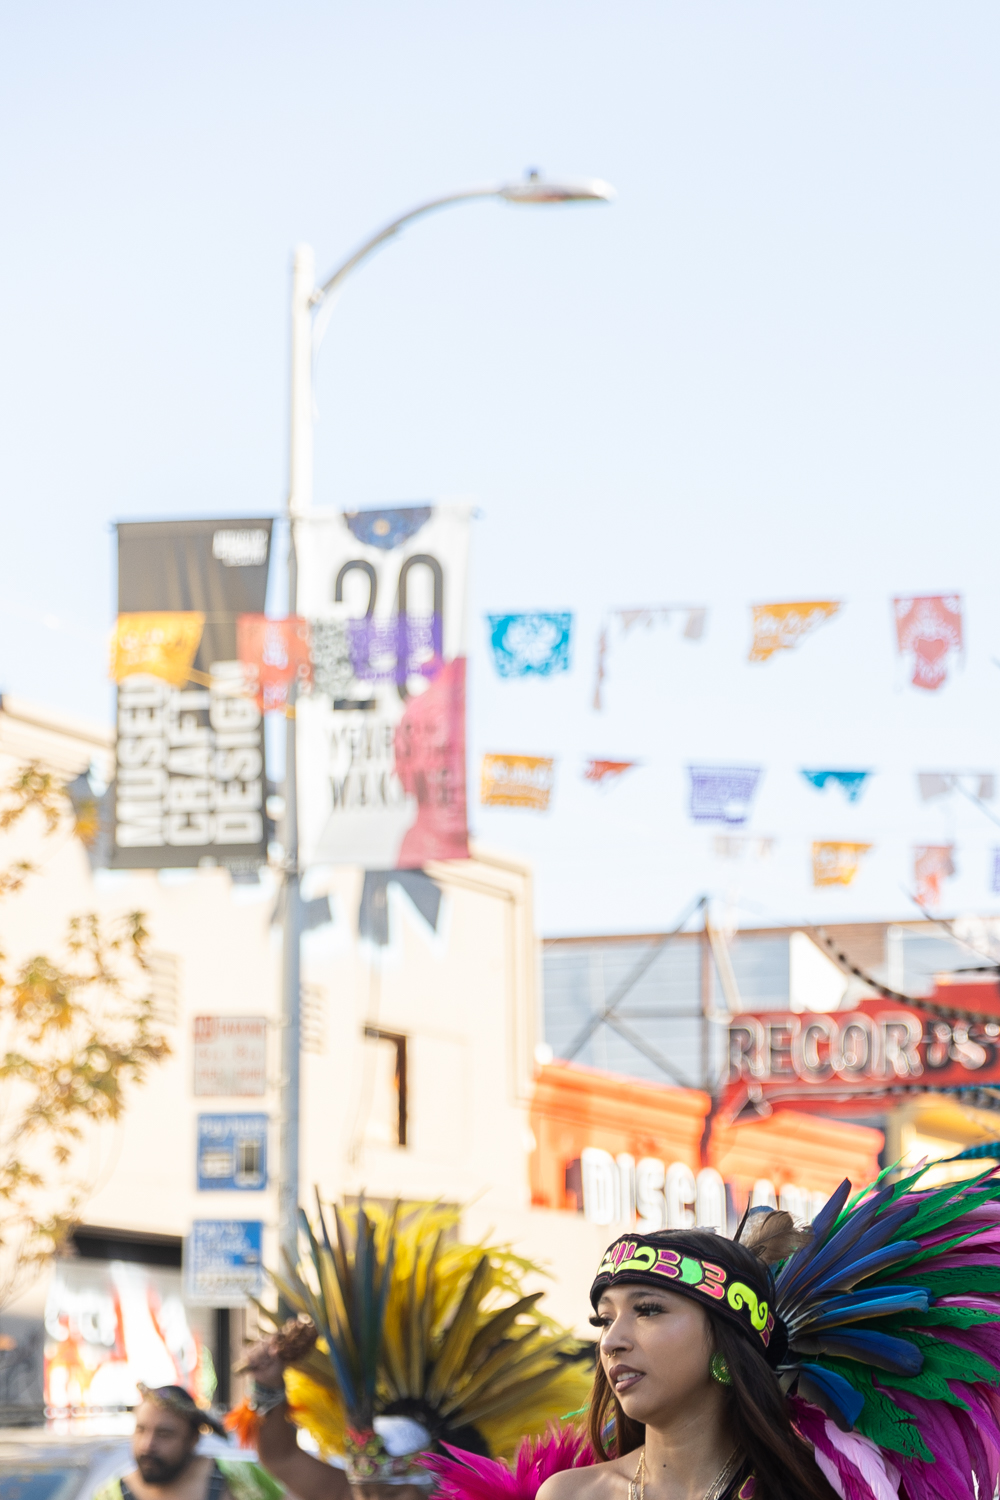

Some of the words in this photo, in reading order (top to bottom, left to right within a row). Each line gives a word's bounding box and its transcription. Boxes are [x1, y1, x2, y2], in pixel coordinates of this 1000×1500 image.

[334, 554, 443, 710] 20
[167, 688, 214, 846] CRAFT
[211, 660, 262, 845] DESIGN
[727, 1009, 997, 1084] RECORDS
